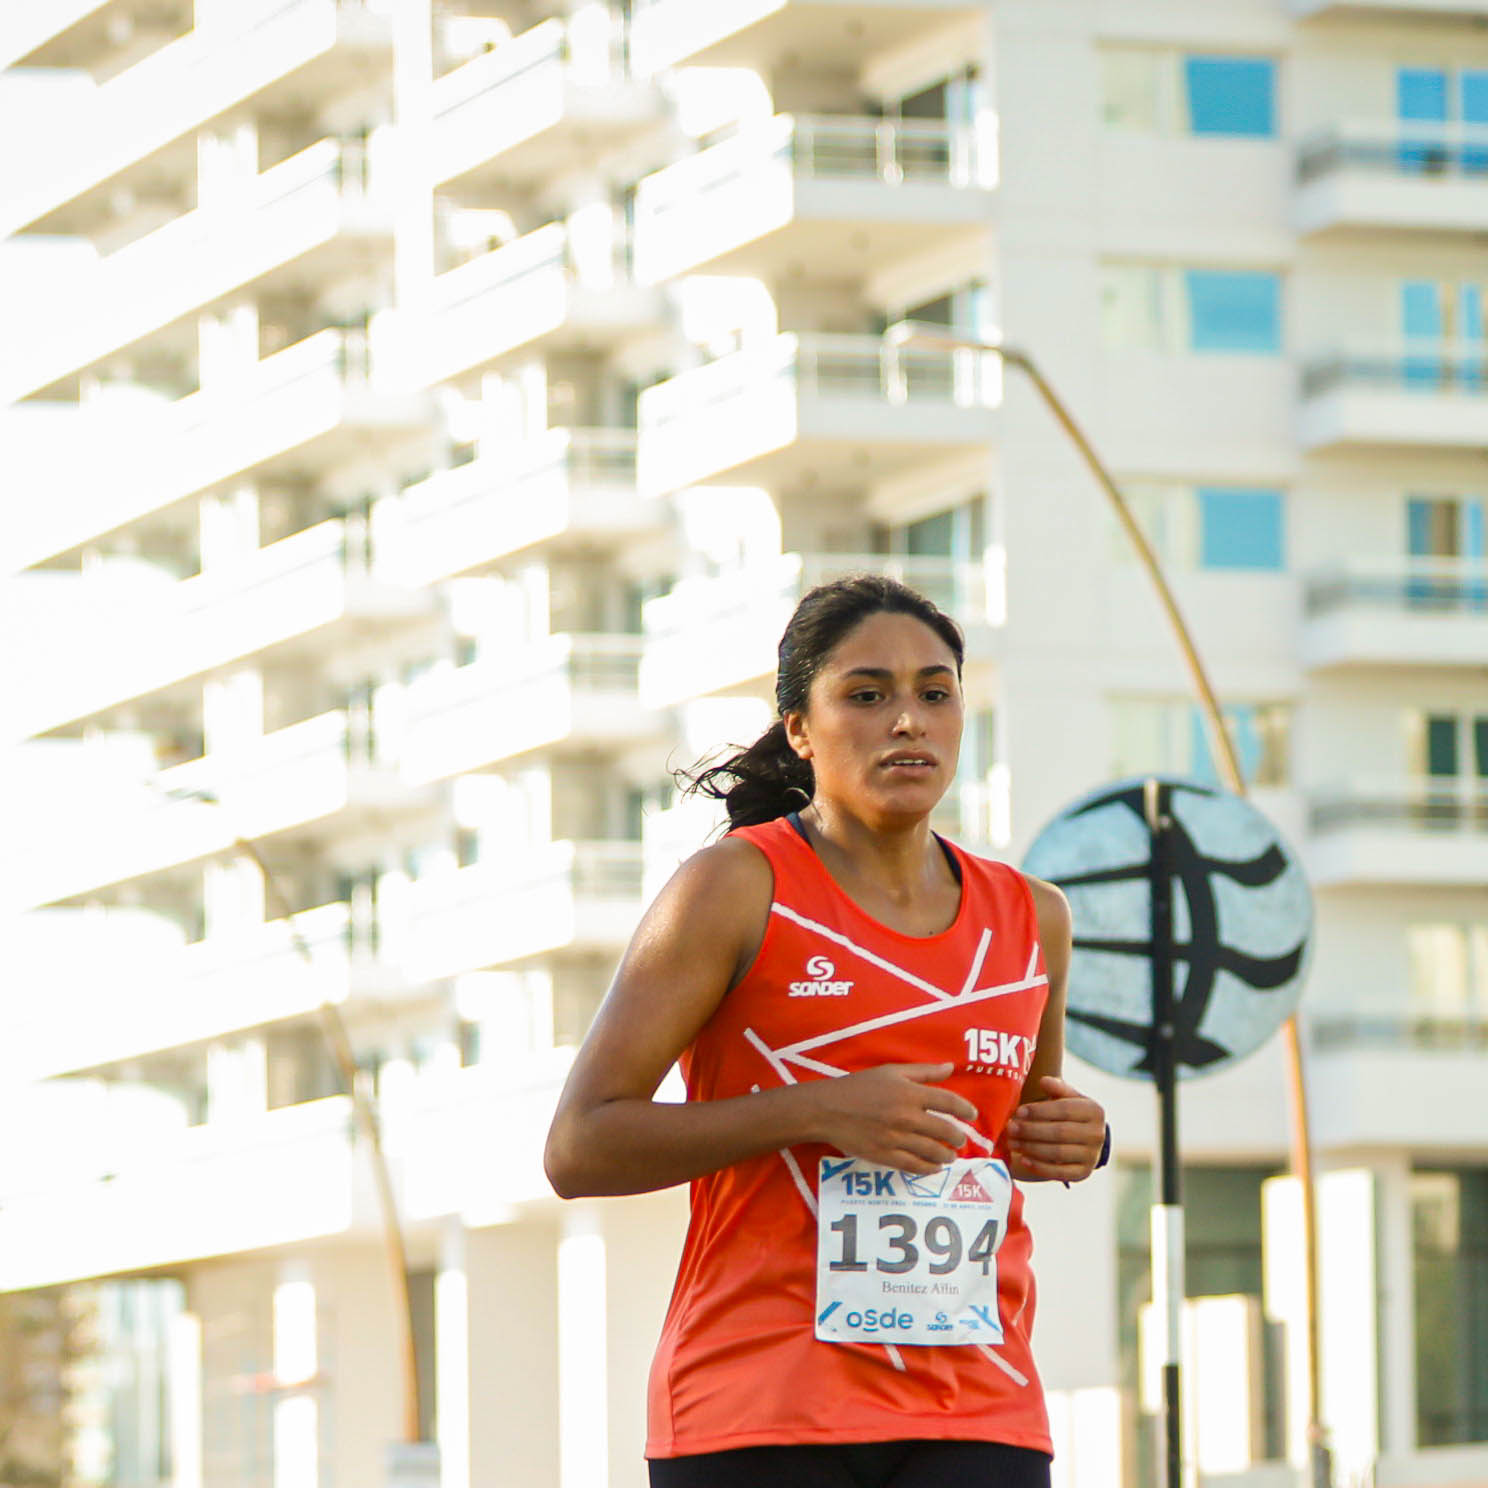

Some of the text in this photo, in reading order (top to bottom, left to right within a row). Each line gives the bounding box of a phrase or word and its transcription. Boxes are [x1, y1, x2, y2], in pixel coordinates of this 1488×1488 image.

[963, 1027, 1020, 1069] 15K
[841, 1170, 897, 1197] 15K
[957, 1183, 983, 1199] 15K
[829, 1213, 1000, 1277] 1394
[845, 1307, 914, 1332] osde
